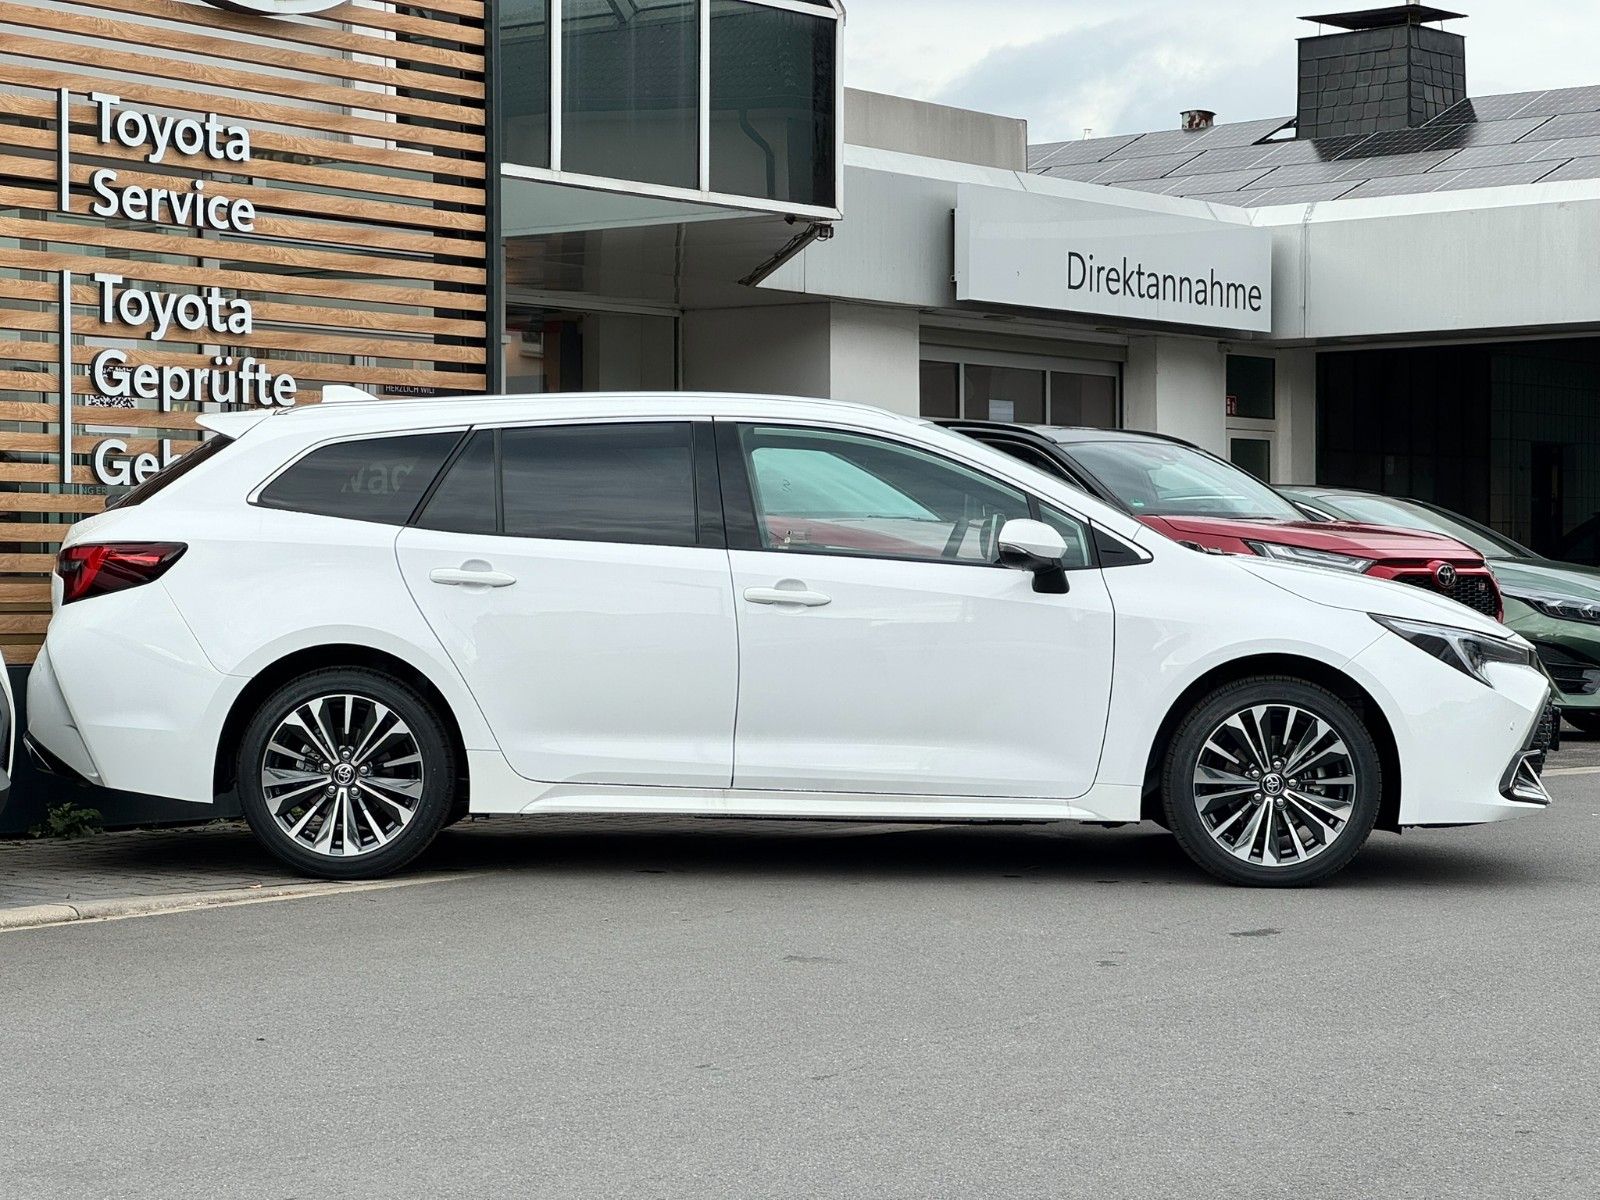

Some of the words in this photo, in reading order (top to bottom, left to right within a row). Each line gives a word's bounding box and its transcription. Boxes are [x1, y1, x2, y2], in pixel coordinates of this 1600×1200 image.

[90, 91, 251, 164] Toyota
[91, 168, 256, 233] Service
[93, 272, 253, 341] Toyota
[1067, 251, 1262, 312] Direktannahme
[93, 349, 297, 412] Geprüfte
